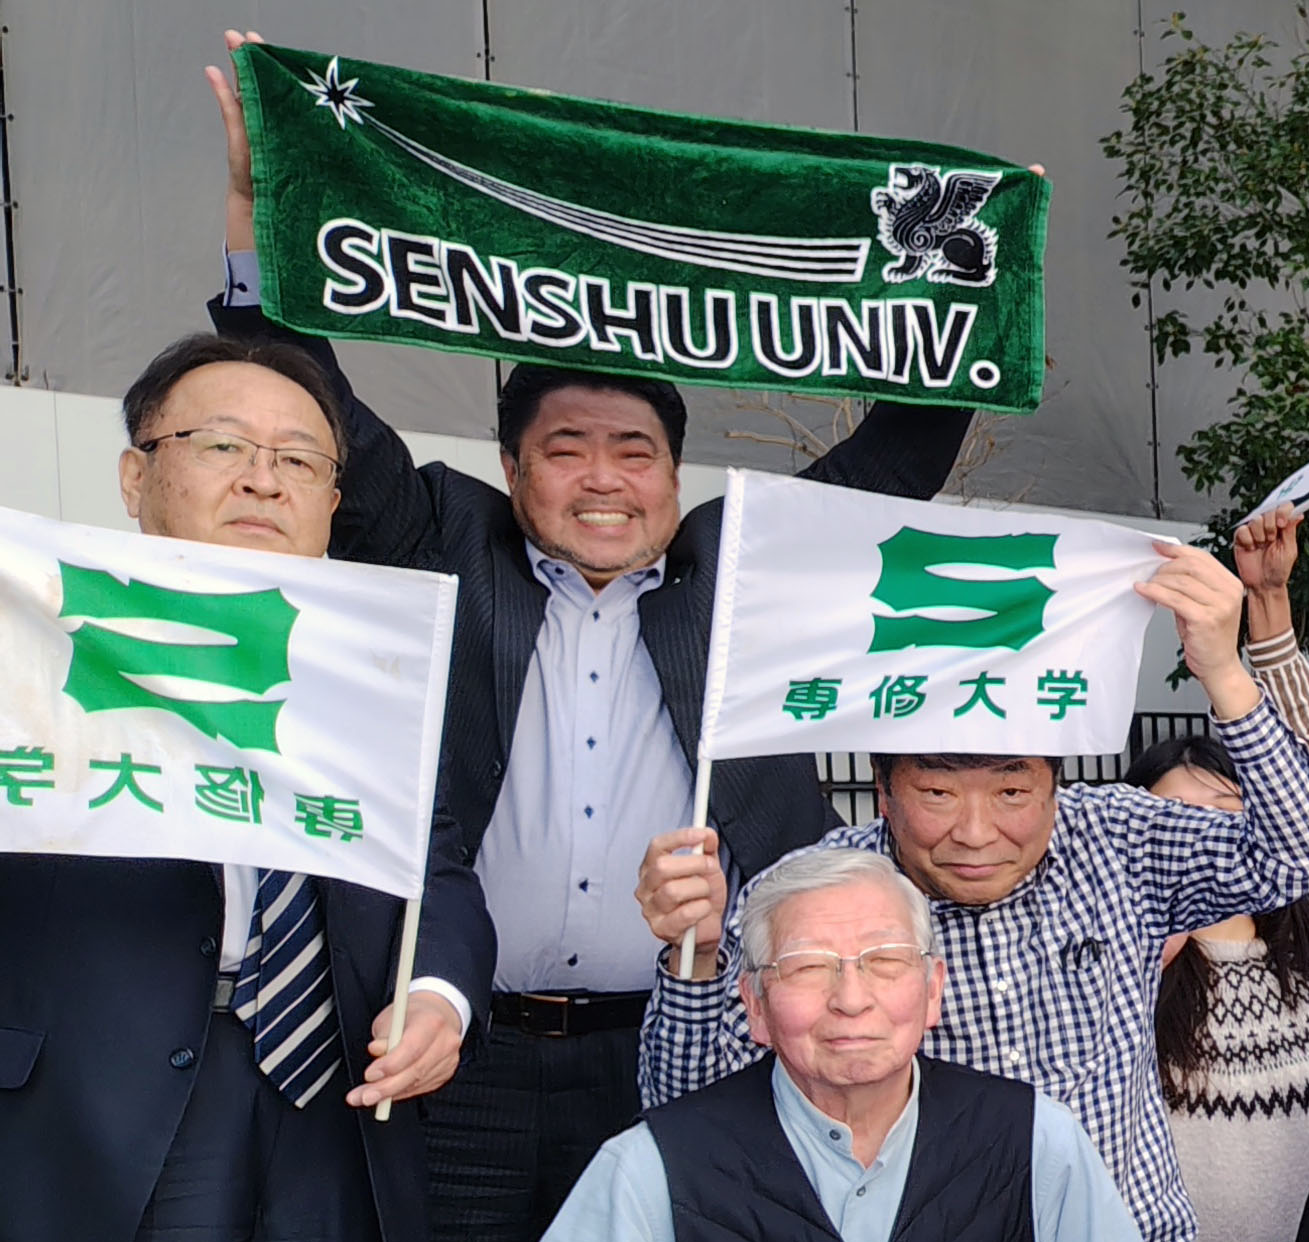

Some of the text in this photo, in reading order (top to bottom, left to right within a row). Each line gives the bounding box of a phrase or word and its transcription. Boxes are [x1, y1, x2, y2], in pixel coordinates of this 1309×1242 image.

[315, 217, 1003, 391] SENSHU UNIV.
[782, 668, 1090, 723] 専修大学
